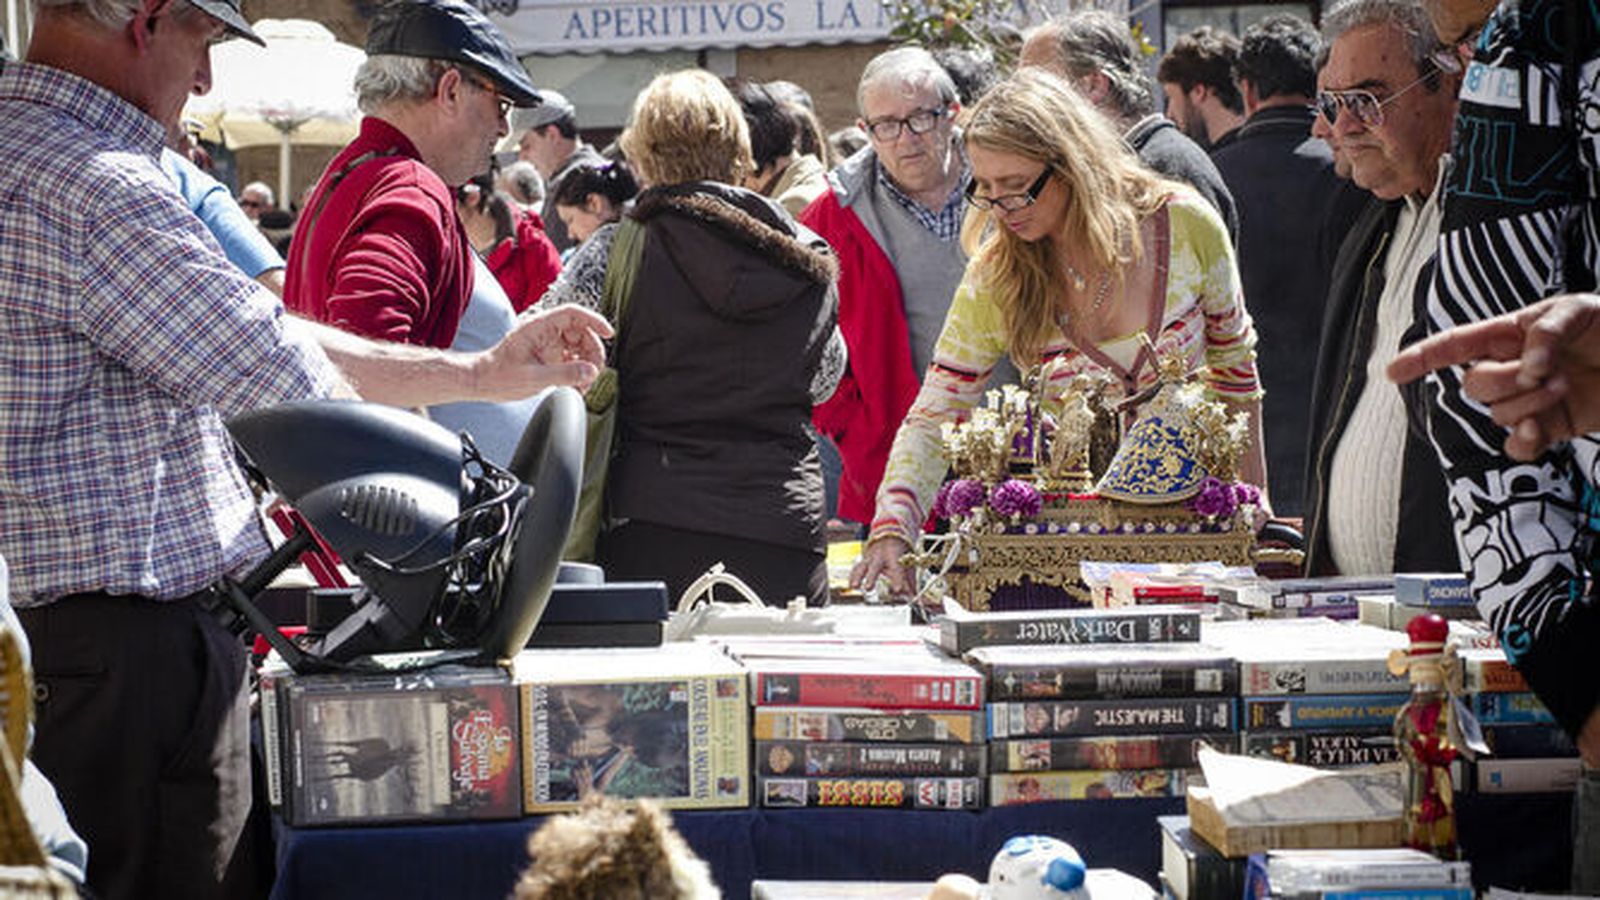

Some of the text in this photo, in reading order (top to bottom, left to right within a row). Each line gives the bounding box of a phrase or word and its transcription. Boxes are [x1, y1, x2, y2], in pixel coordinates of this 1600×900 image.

[563, 2, 785, 39] APERITIVOS
[816, 1, 861, 30] LA
[1093, 709, 1159, 726] MAJESTIC
[1160, 707, 1185, 724] THE
